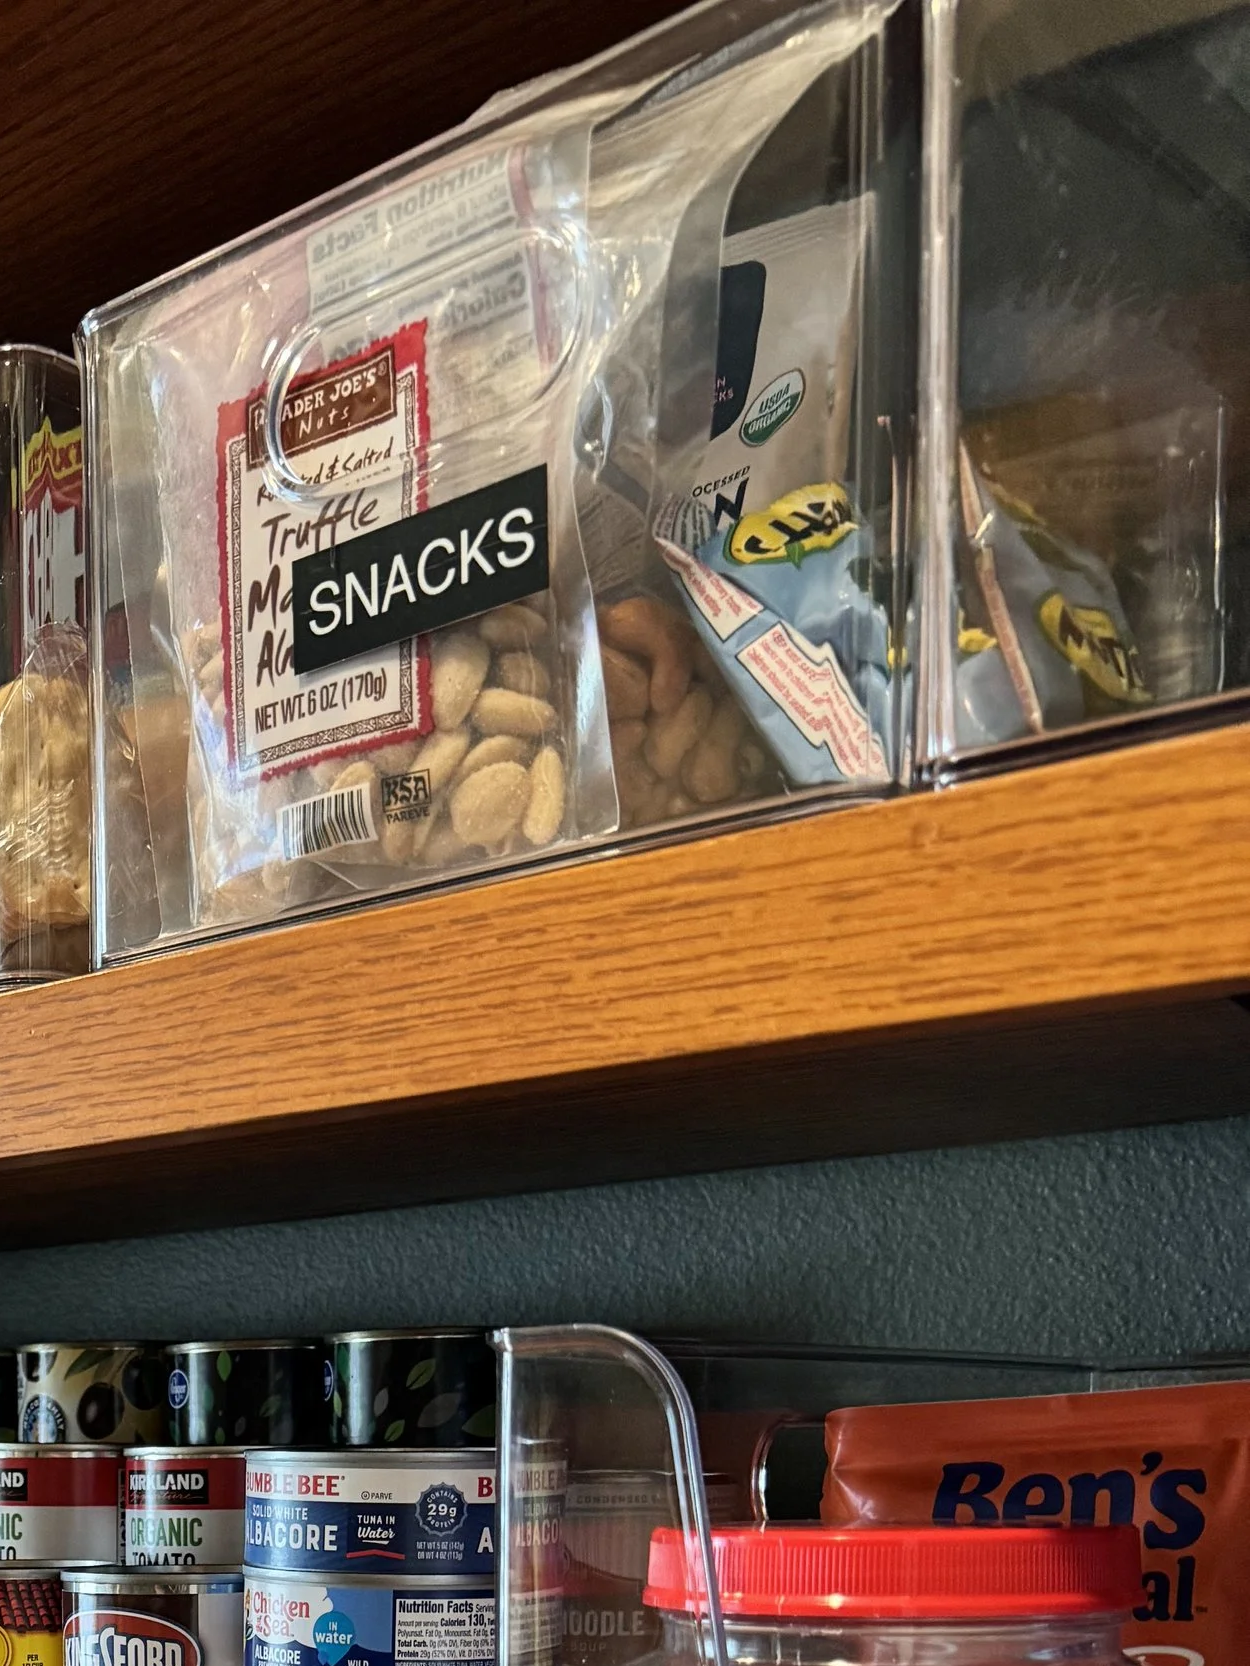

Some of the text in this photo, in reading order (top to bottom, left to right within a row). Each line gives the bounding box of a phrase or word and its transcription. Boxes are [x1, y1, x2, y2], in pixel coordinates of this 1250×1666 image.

[329, 366, 378, 402] JOE'S
[758, 382, 791, 415] USDA
[298, 405, 351, 440] Nuts
[342, 434, 395, 474] Salted
[260, 487, 381, 566] Truffle
[307, 505, 537, 638] SNACKS
[254, 666, 388, 735] NET WT. 6 OZ (170g)
[385, 806, 430, 825] PAREVE
[129, 1473, 205, 1491] KIRKLAND
[246, 1471, 340, 1497] BUMBLE BEE
[370, 1491, 394, 1501] PARVE
[426, 1490, 458, 1504] CONTAINS
[576, 1492, 648, 1506] CONDENSED
[931, 1450, 1209, 1551] Ben's
[251, 1503, 309, 1521] SOLID WHITE
[357, 1514, 384, 1526] TUNA
[427, 1502, 458, 1518] 29g
[130, 1516, 203, 1547] ORGANIC
[356, 1526, 396, 1541] Water
[252, 1590, 311, 1622] Chicken
[397, 1599, 474, 1614] Nutrition Facts
[439, 1612, 488, 1629] Calories 130,
[315, 1630, 354, 1645] water
[253, 1643, 302, 1666] ALBACORE
